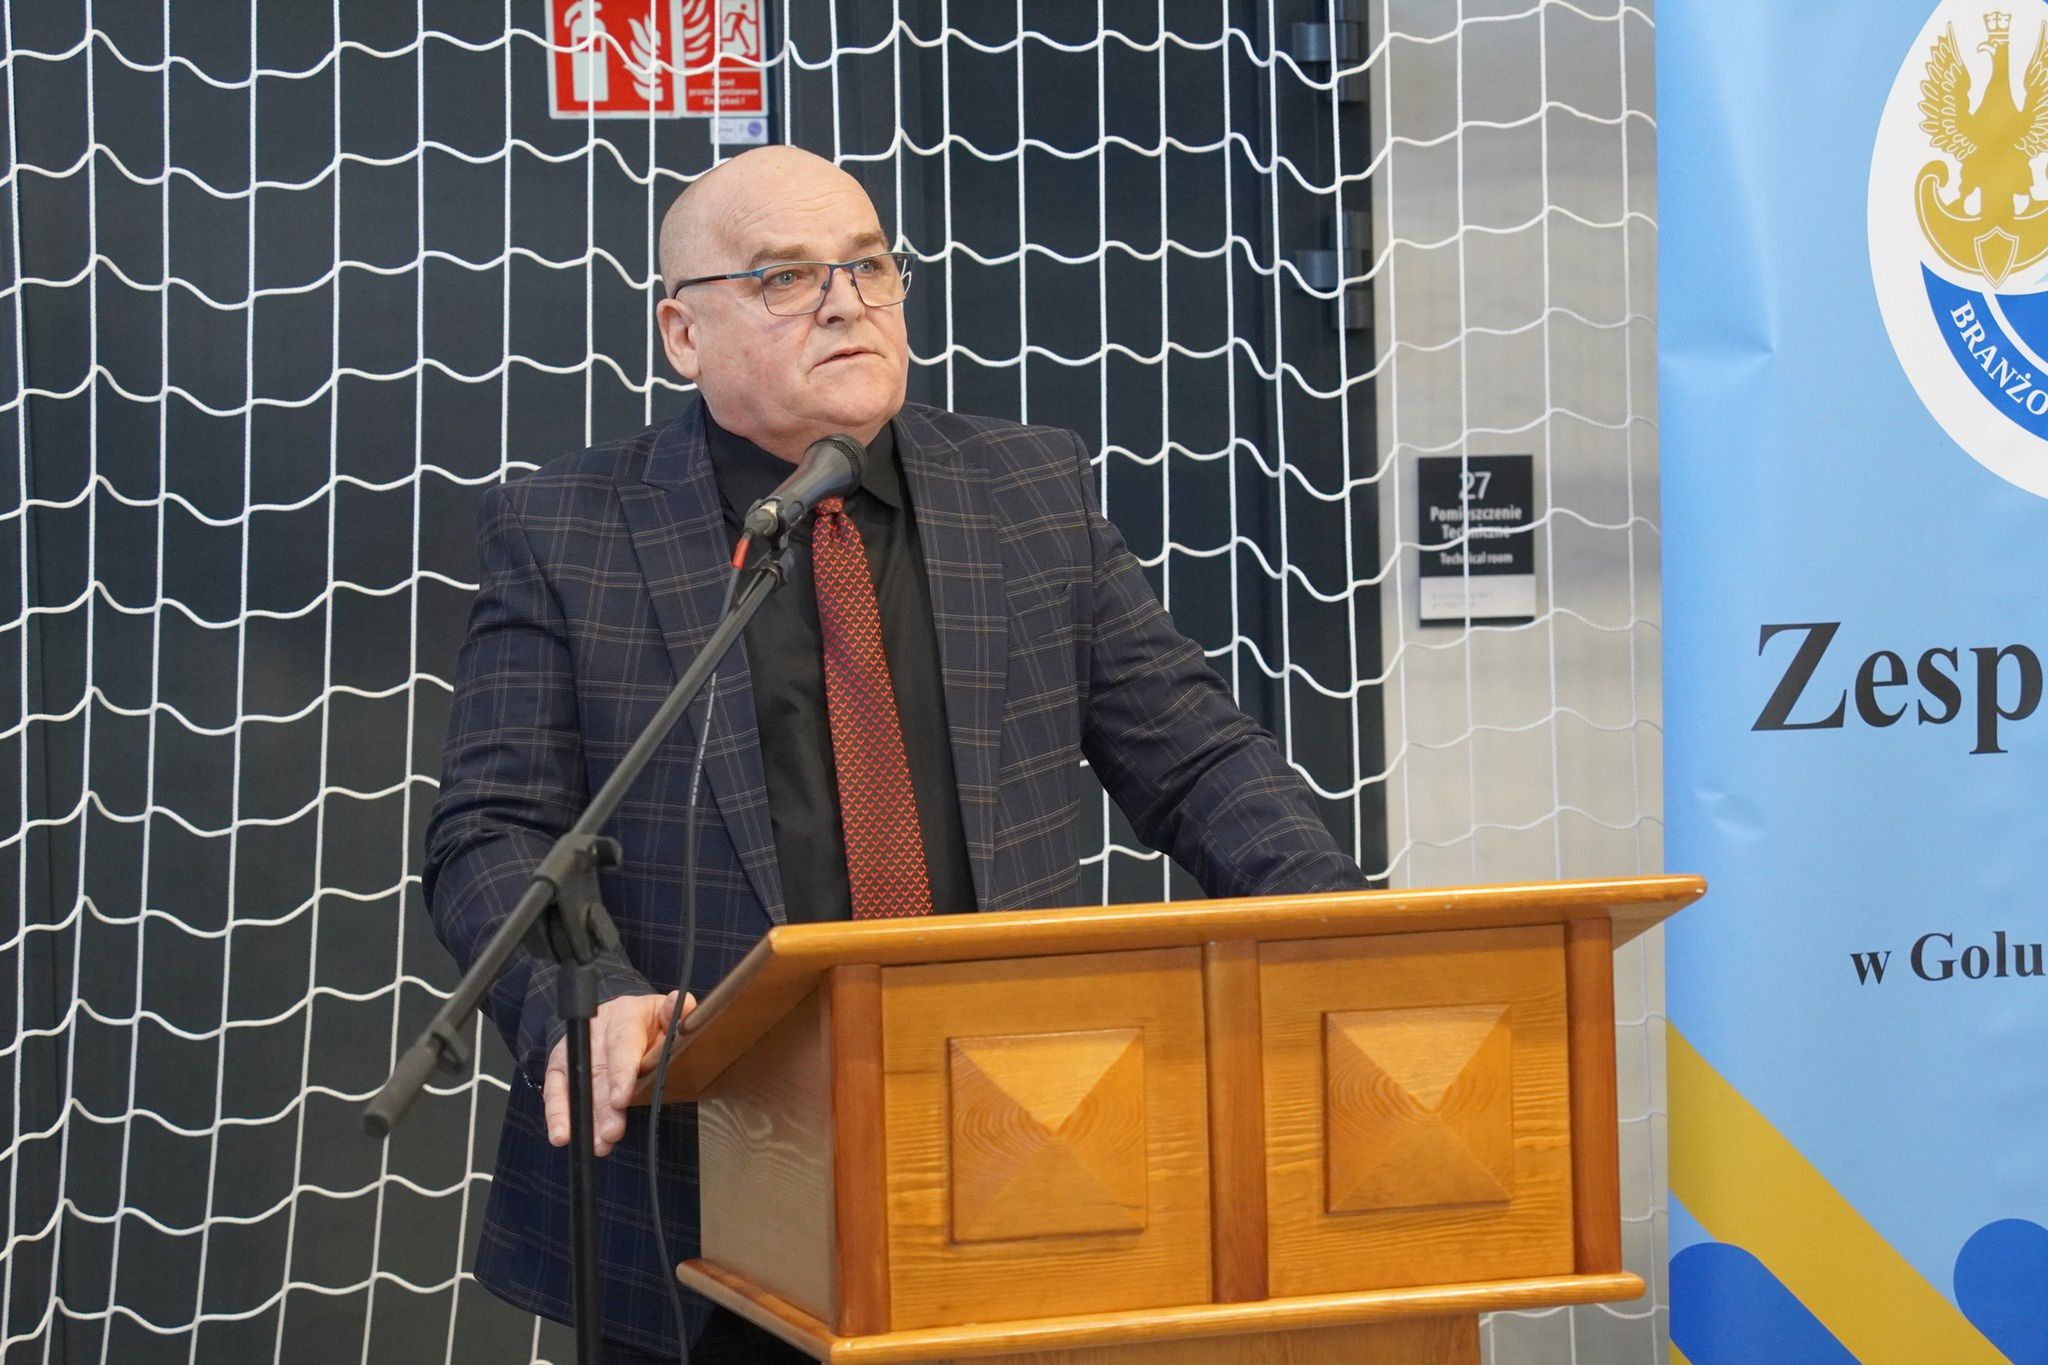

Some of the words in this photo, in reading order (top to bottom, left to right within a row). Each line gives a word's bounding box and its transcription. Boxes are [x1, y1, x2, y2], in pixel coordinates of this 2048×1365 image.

[1949, 299, 2048, 416] BRANŻO
[1458, 471, 1492, 500] 27
[1429, 504, 1523, 522] Pomiszczenie
[1440, 552, 1486, 565] Techical
[1750, 621, 2043, 755] Zesp
[1849, 950, 1893, 986] w
[1910, 930, 2047, 982] Golu
